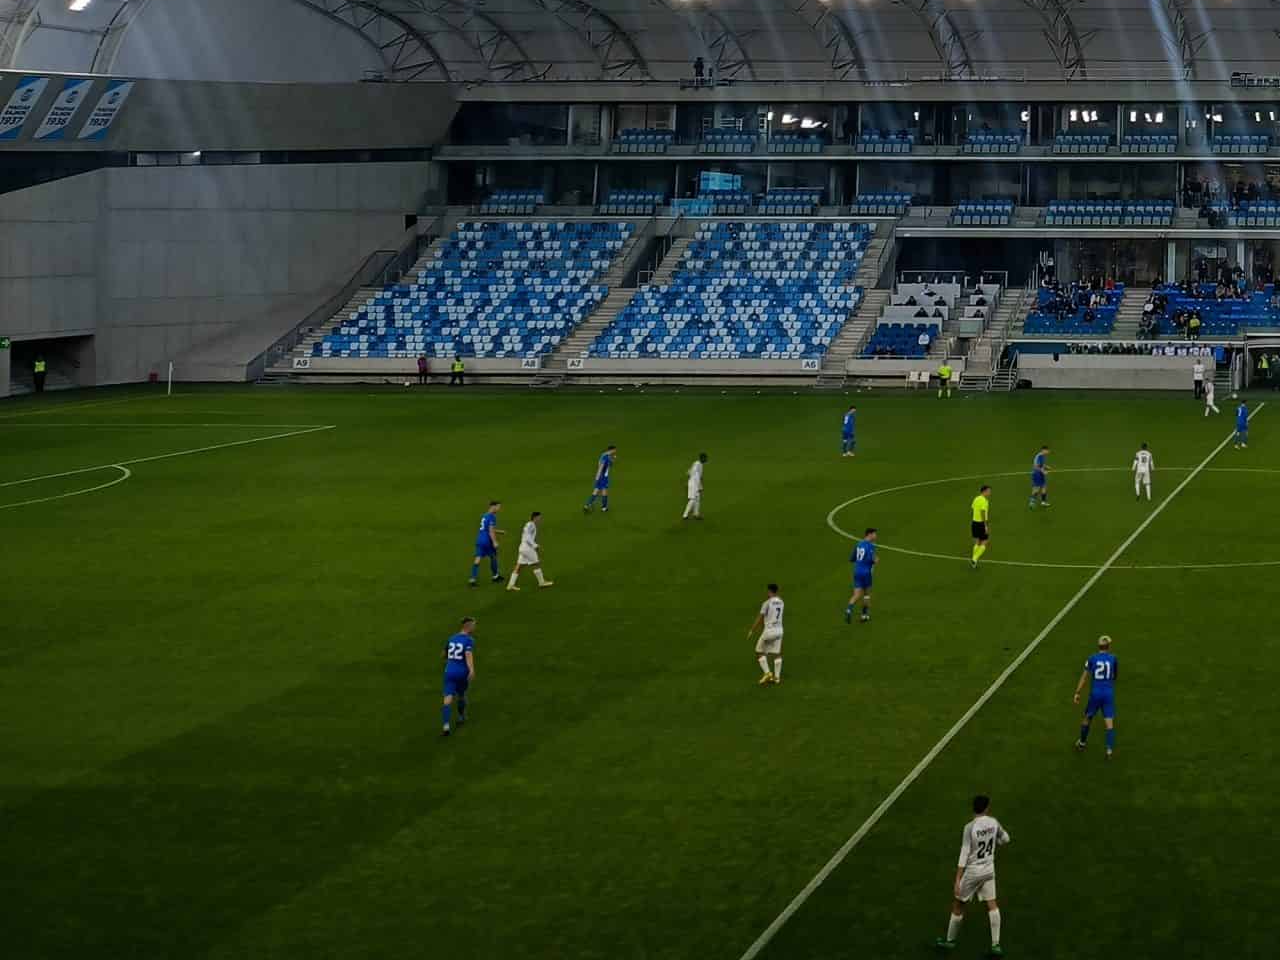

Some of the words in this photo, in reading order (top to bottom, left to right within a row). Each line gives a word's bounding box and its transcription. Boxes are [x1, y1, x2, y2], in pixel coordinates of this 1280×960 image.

[447, 642, 463, 660] 22
[1094, 660, 1110, 680] 21
[977, 837, 994, 859] 24
